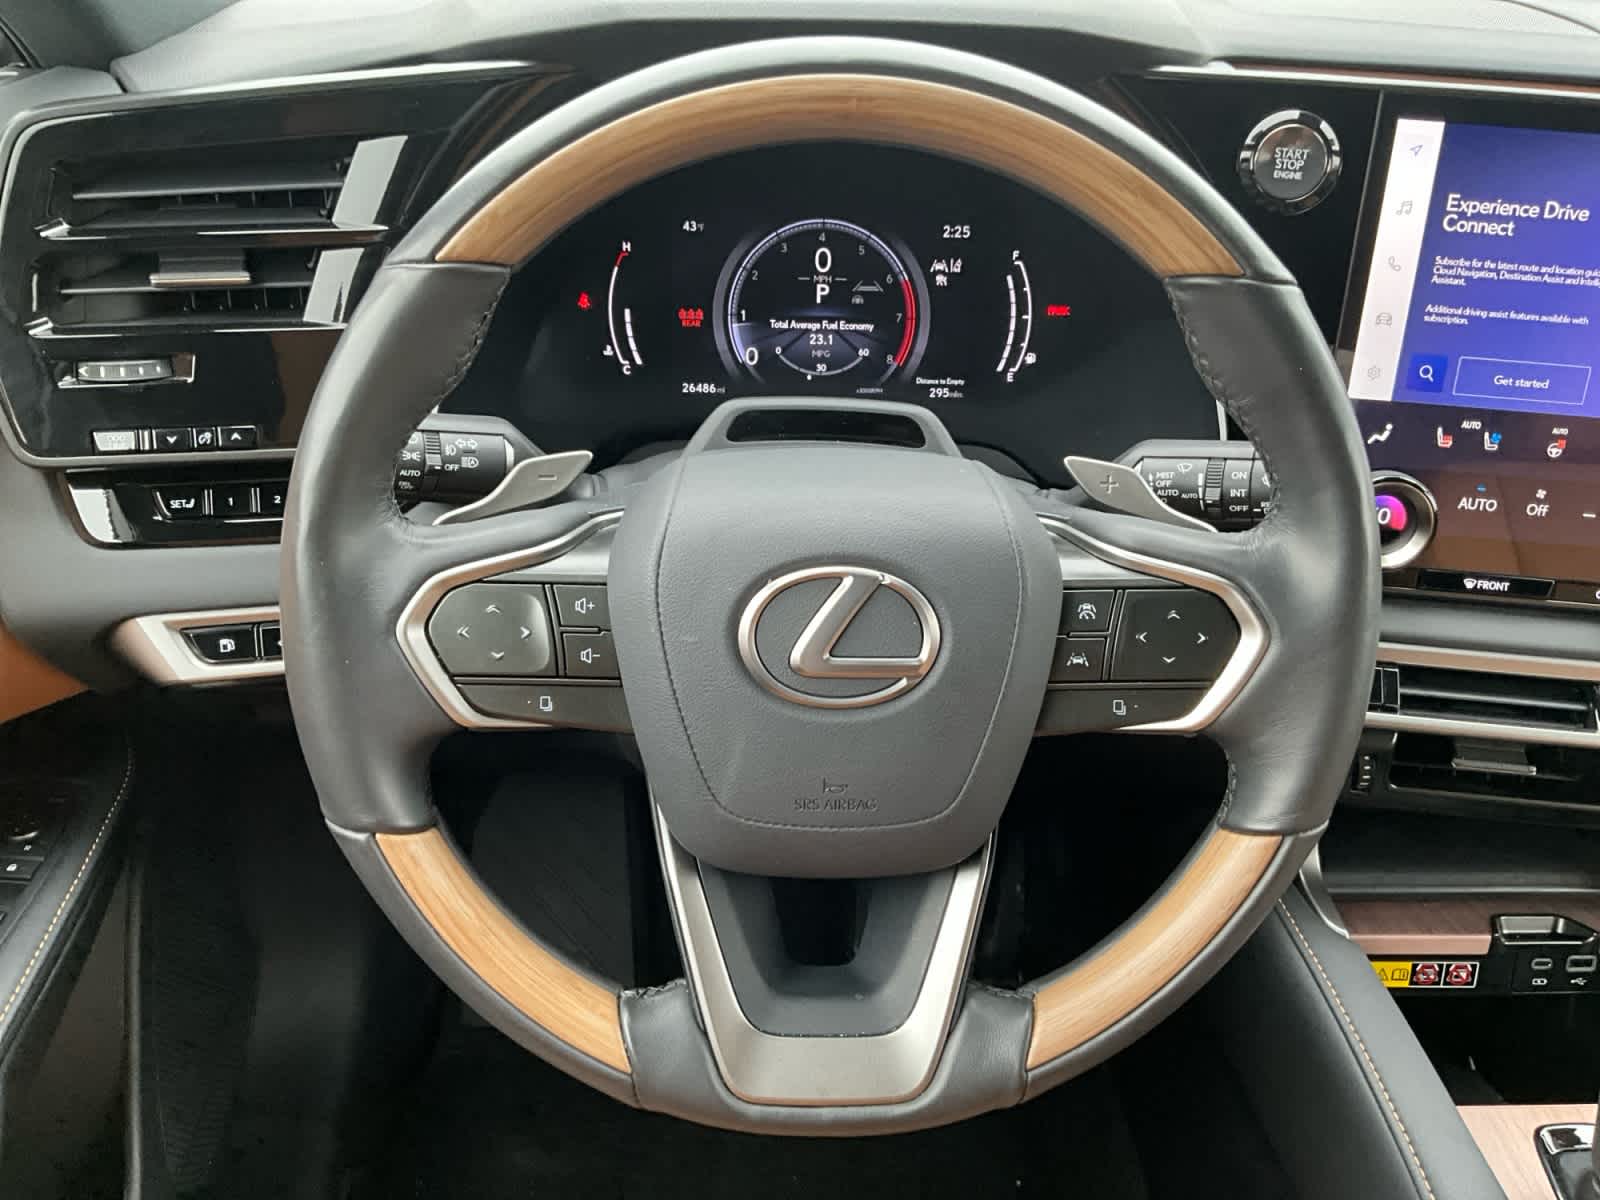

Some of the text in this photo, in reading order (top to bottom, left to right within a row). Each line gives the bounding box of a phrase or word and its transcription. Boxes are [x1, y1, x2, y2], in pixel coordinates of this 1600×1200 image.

[1274, 147, 1310, 160] START
[1274, 159, 1304, 170] STOP
[1273, 170, 1303, 180] ENGINE
[1446, 194, 1590, 222] Experience Drive
[1442, 214, 1515, 237] Connect
[818, 232, 826, 242] 4
[943, 225, 971, 239] 2:25
[622, 241, 632, 251] H
[781, 243, 788, 253] 3
[858, 245, 865, 256] 5
[814, 247, 832, 273] 0
[1012, 250, 1020, 260] F
[1434, 255, 1471, 268] Subscribe
[1471, 258, 1482, 268] for
[1484, 259, 1496, 269] the
[1497, 260, 1518, 271] latest
[1519, 262, 1539, 273] route
[1540, 264, 1555, 274] and
[1555, 265, 1584, 276] location
[751, 271, 759, 281] 2
[814, 275, 832, 284] MPH
[886, 274, 893, 284] 6
[1433, 266, 1457, 275] Cloud
[1500, 271, 1542, 282] Destination
[1542, 274, 1564, 284] Assist
[1565, 275, 1580, 285] and
[816, 284, 830, 303] P
[740, 310, 746, 321] 1
[896, 313, 902, 323] 7
[1425, 303, 1463, 315] Additional
[1463, 306, 1487, 319] driving
[1488, 309, 1509, 319] assist
[1509, 310, 1540, 321] features
[1571, 314, 1589, 326] with
[769, 319, 874, 333] Total Average Fuel Economy
[809, 334, 833, 345] 23.1
[775, 346, 782, 354] 0
[811, 350, 831, 358] MPG
[858, 348, 870, 357] 60
[745, 347, 759, 365] 0
[886, 354, 894, 364] 8
[623, 365, 632, 375] C
[816, 364, 827, 372] 30
[916, 376, 939, 385] Distance
[946, 376, 965, 386] Empty
[1006, 372, 1014, 382] E
[1493, 374, 1549, 390] Get started
[682, 383, 717, 393] 26486
[929, 387, 949, 398] 295
[1461, 420, 1482, 430] AUTO
[1552, 427, 1569, 435] AUTO
[444, 464, 460, 472] OFF
[1155, 471, 1175, 479] MIST
[1231, 471, 1248, 480] ON
[1156, 489, 1179, 497] AUTO
[1229, 488, 1248, 497] INT
[170, 500, 187, 509] SET
[228, 497, 234, 506] 1
[274, 495, 281, 504] 2
[1457, 497, 1498, 512] AUTO
[1526, 503, 1549, 517] Off
[1375, 507, 1391, 525] 0
[1477, 580, 1510, 592] FRONT
[794, 799, 878, 811] SRS AIRBAG
